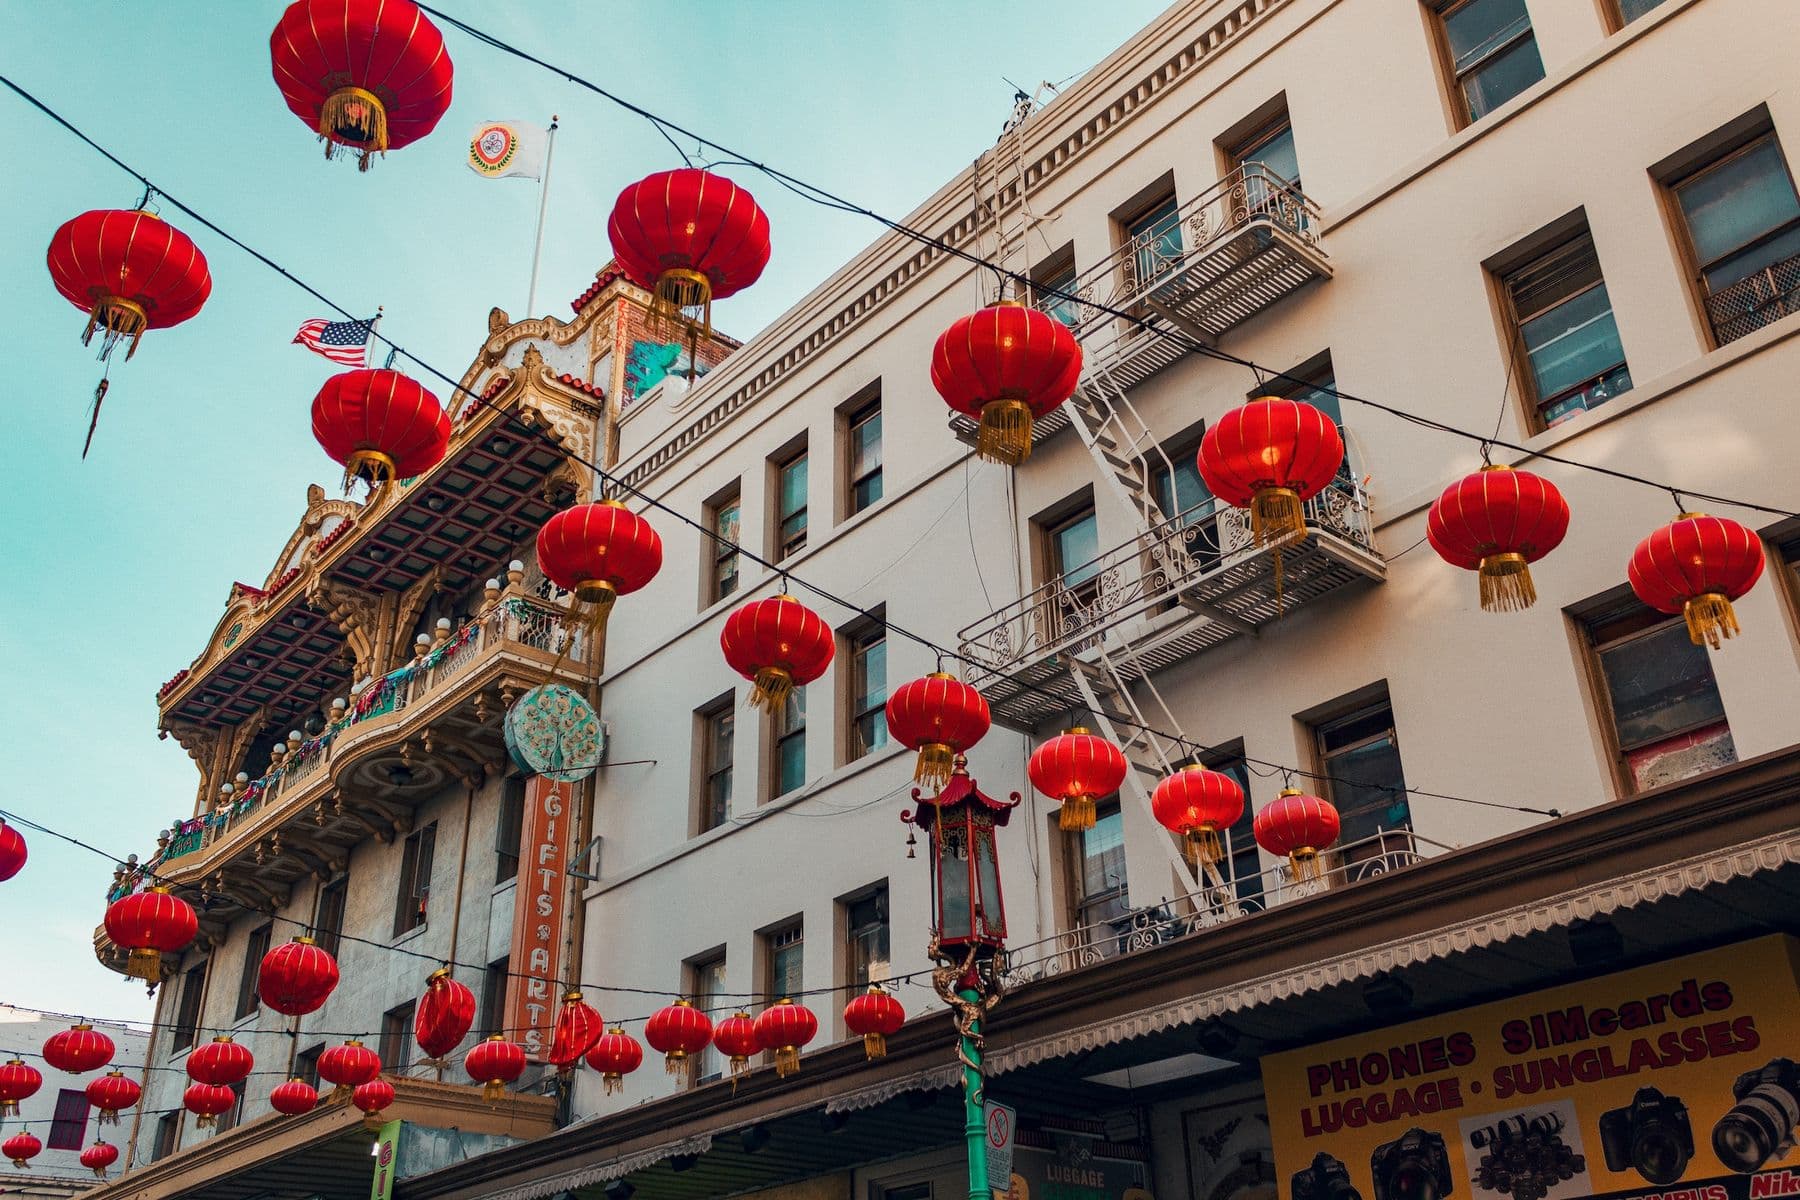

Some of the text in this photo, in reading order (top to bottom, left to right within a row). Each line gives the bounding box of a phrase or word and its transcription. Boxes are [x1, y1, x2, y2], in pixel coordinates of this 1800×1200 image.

[526, 795, 562, 1053] GIFTS & ARTS
[1301, 1015, 1760, 1137] LUGGAGE SUNGLASSES
[1306, 979, 1733, 1097] PHONES SIMcards
[377, 1140, 393, 1200] GI
